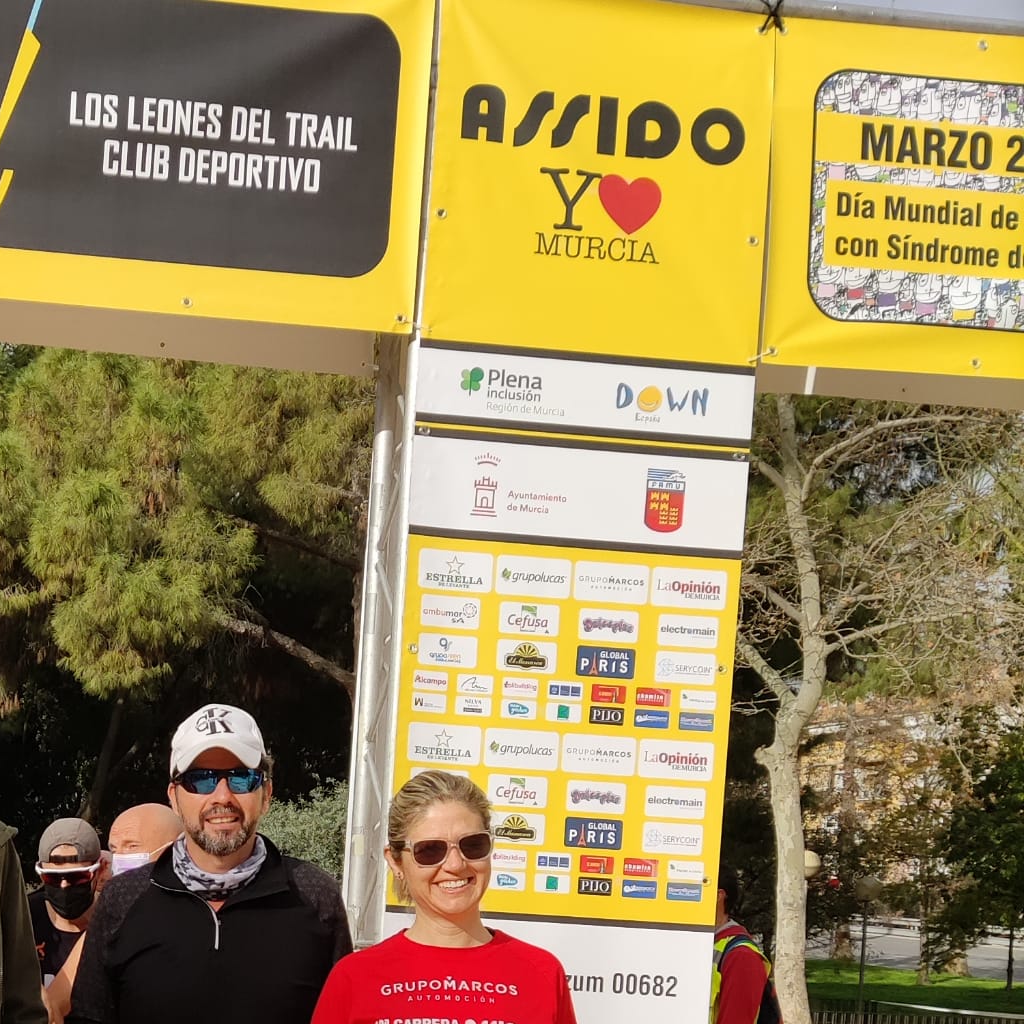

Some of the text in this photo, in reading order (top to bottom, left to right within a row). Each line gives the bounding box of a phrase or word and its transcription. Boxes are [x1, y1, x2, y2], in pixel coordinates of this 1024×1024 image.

[69, 90, 358, 152] LOS LEONES DEL TRAIL
[461, 83, 746, 166] ASSIDO
[860, 121, 993, 171] MARZO
[102, 138, 321, 193] CLUB DEPORTIVO
[539, 166, 603, 231] Y
[836, 190, 1019, 231] Día Mundial de
[533, 231, 660, 265] MURCIA
[834, 233, 1024, 269] con Síndrome d
[487, 368, 543, 391] Plena
[487, 386, 542, 403] inclusión
[486, 401, 565, 417] Región de Murcia
[507, 490, 567, 503] Ayuntamiento
[506, 503, 549, 514] de Murcia
[425, 572, 483, 585] ESTRELLA
[512, 571, 566, 584] grupolucas
[507, 613, 549, 630] Cefusa
[660, 624, 716, 637] electromain
[600, 650, 630, 660] GLOBAL
[592, 709, 622, 722] PIJO
[414, 745, 472, 758] ESTRELLA
[500, 743, 554, 756] grupolucas
[495, 785, 537, 801] Cefusa
[647, 795, 703, 808] electromain
[587, 822, 617, 832] GLOBAL
[581, 880, 610, 893] PIJO
[612, 972, 679, 998] 00682
